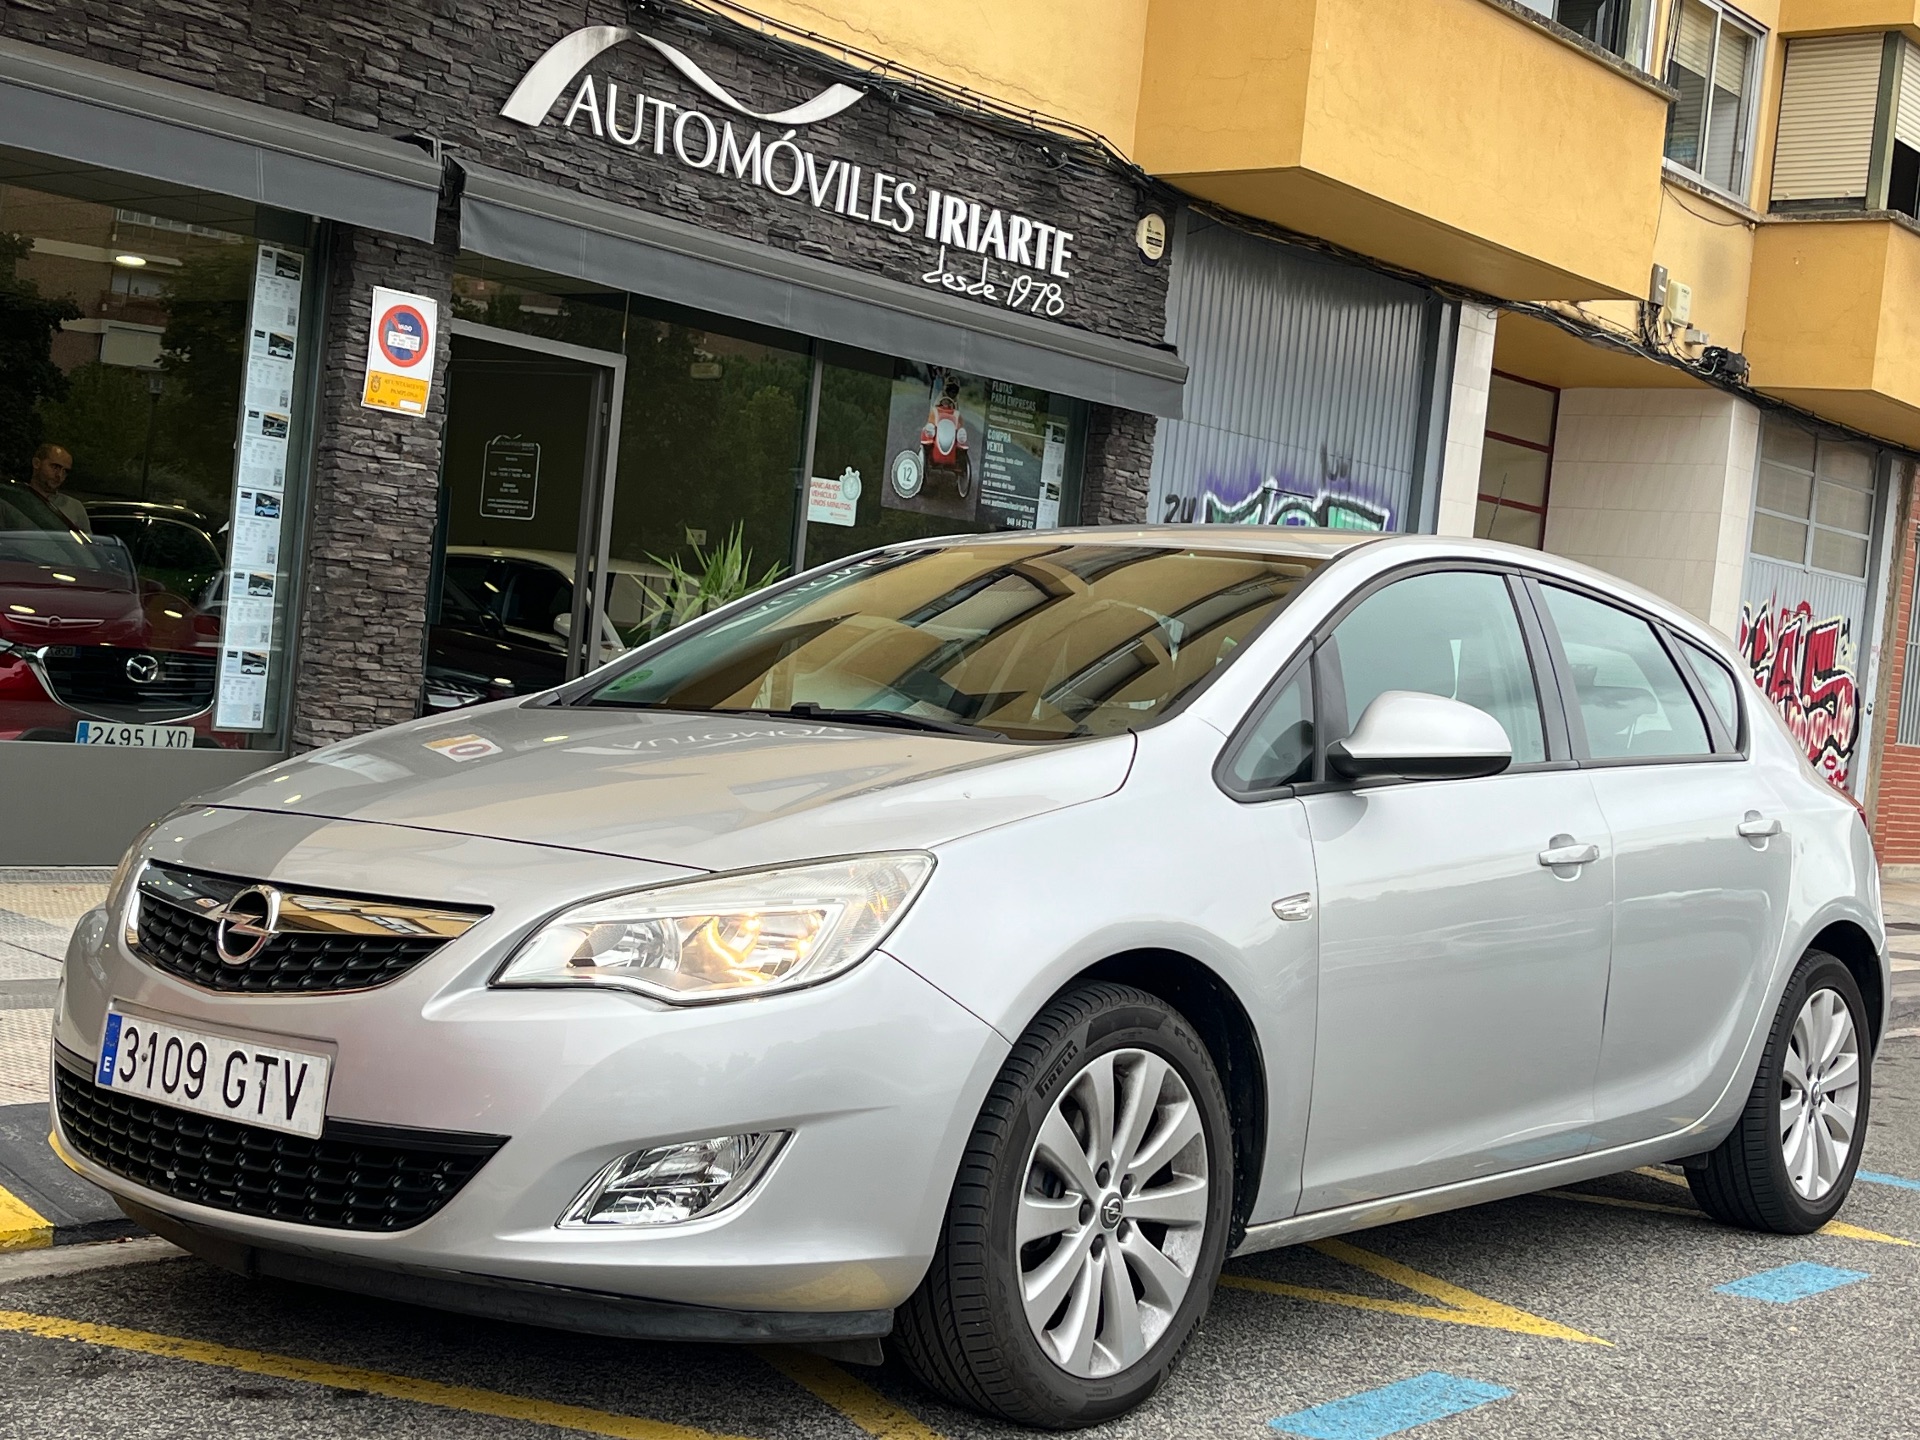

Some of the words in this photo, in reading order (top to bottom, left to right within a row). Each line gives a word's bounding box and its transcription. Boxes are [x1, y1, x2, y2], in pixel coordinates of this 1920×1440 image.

[563, 74, 917, 232] AUTOMÓVILES
[925, 190, 1074, 279] IRIARTE
[922, 245, 998, 300] desde
[1006, 275, 1065, 316] 1978
[987, 429, 1011, 443] COMPRA
[986, 440, 1004, 454] VENTA
[903, 466, 912, 482] 12
[91, 726, 145, 747] 2495
[103, 1056, 112, 1072] E
[119, 1027, 207, 1099] 3109
[222, 1050, 308, 1121] GTV
[1034, 1039, 1079, 1100] PIRELLI
